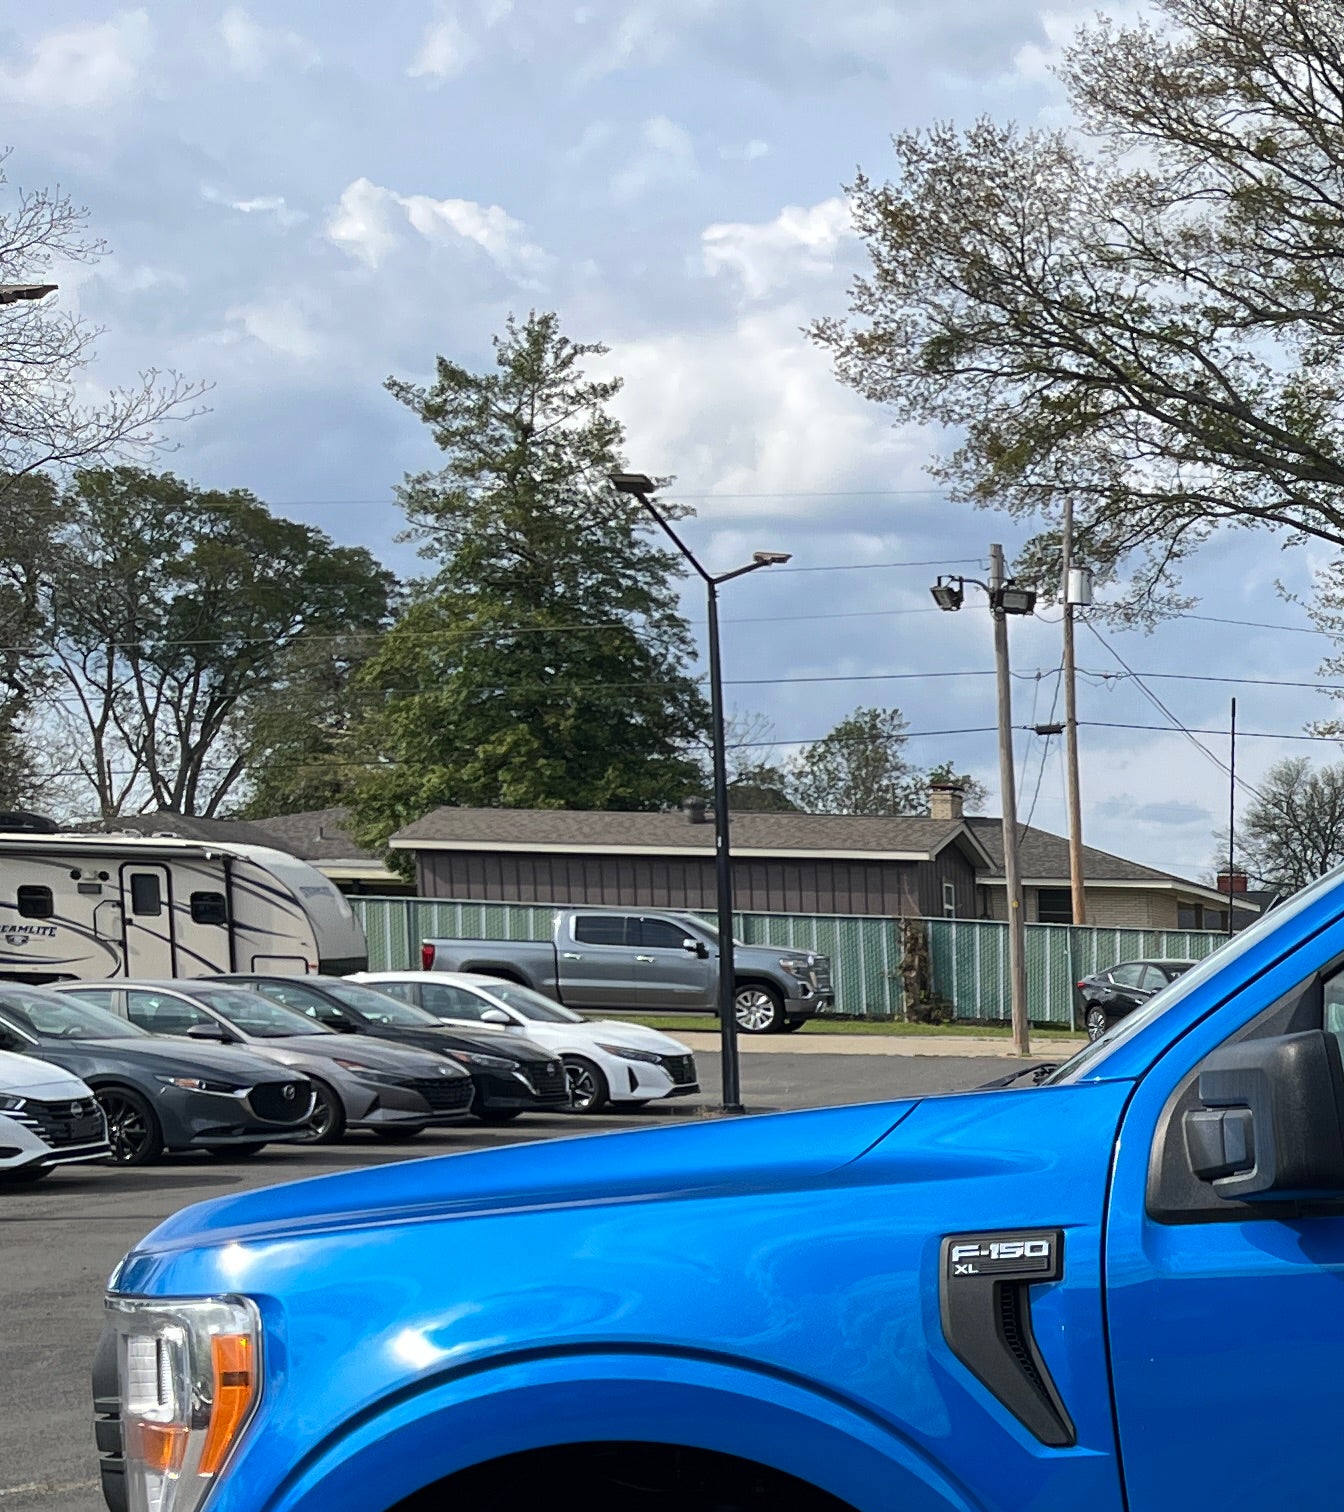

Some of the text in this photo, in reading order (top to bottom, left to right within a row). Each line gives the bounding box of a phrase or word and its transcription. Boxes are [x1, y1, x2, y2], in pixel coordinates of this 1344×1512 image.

[0, 925, 57, 937] EAMLITE
[952, 1240, 1049, 1262] F-150
[954, 1263, 979, 1275] XL
